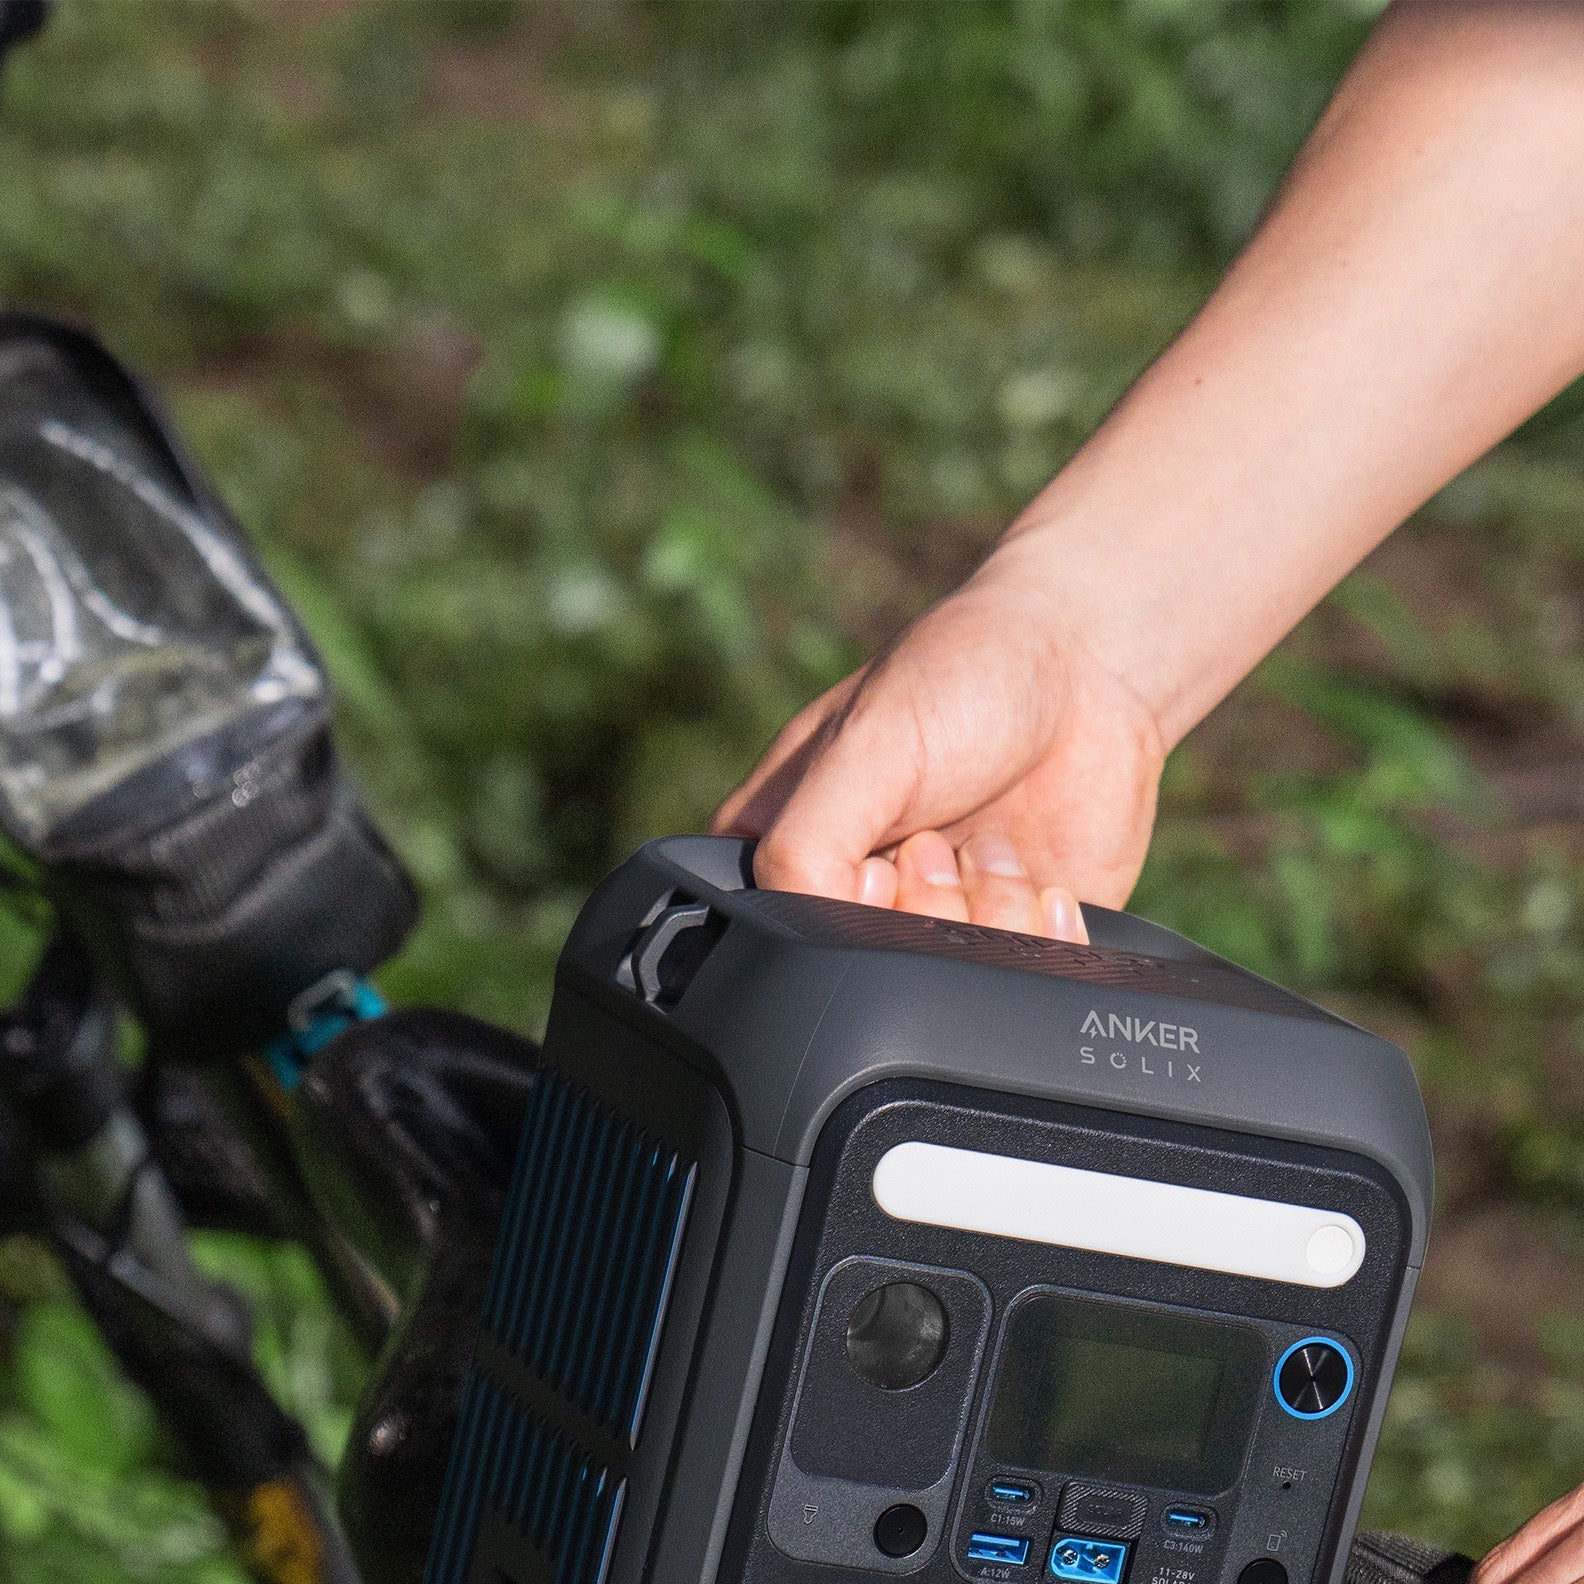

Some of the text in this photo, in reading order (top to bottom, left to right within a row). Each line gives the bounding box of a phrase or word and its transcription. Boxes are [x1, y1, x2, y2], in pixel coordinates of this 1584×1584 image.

[1079, 1009, 1201, 1054] ANKER
[1079, 1046, 1202, 1083] SOLIX
[1272, 1466, 1308, 1481] RESET
[1159, 1567, 1195, 1580] 11-28V
